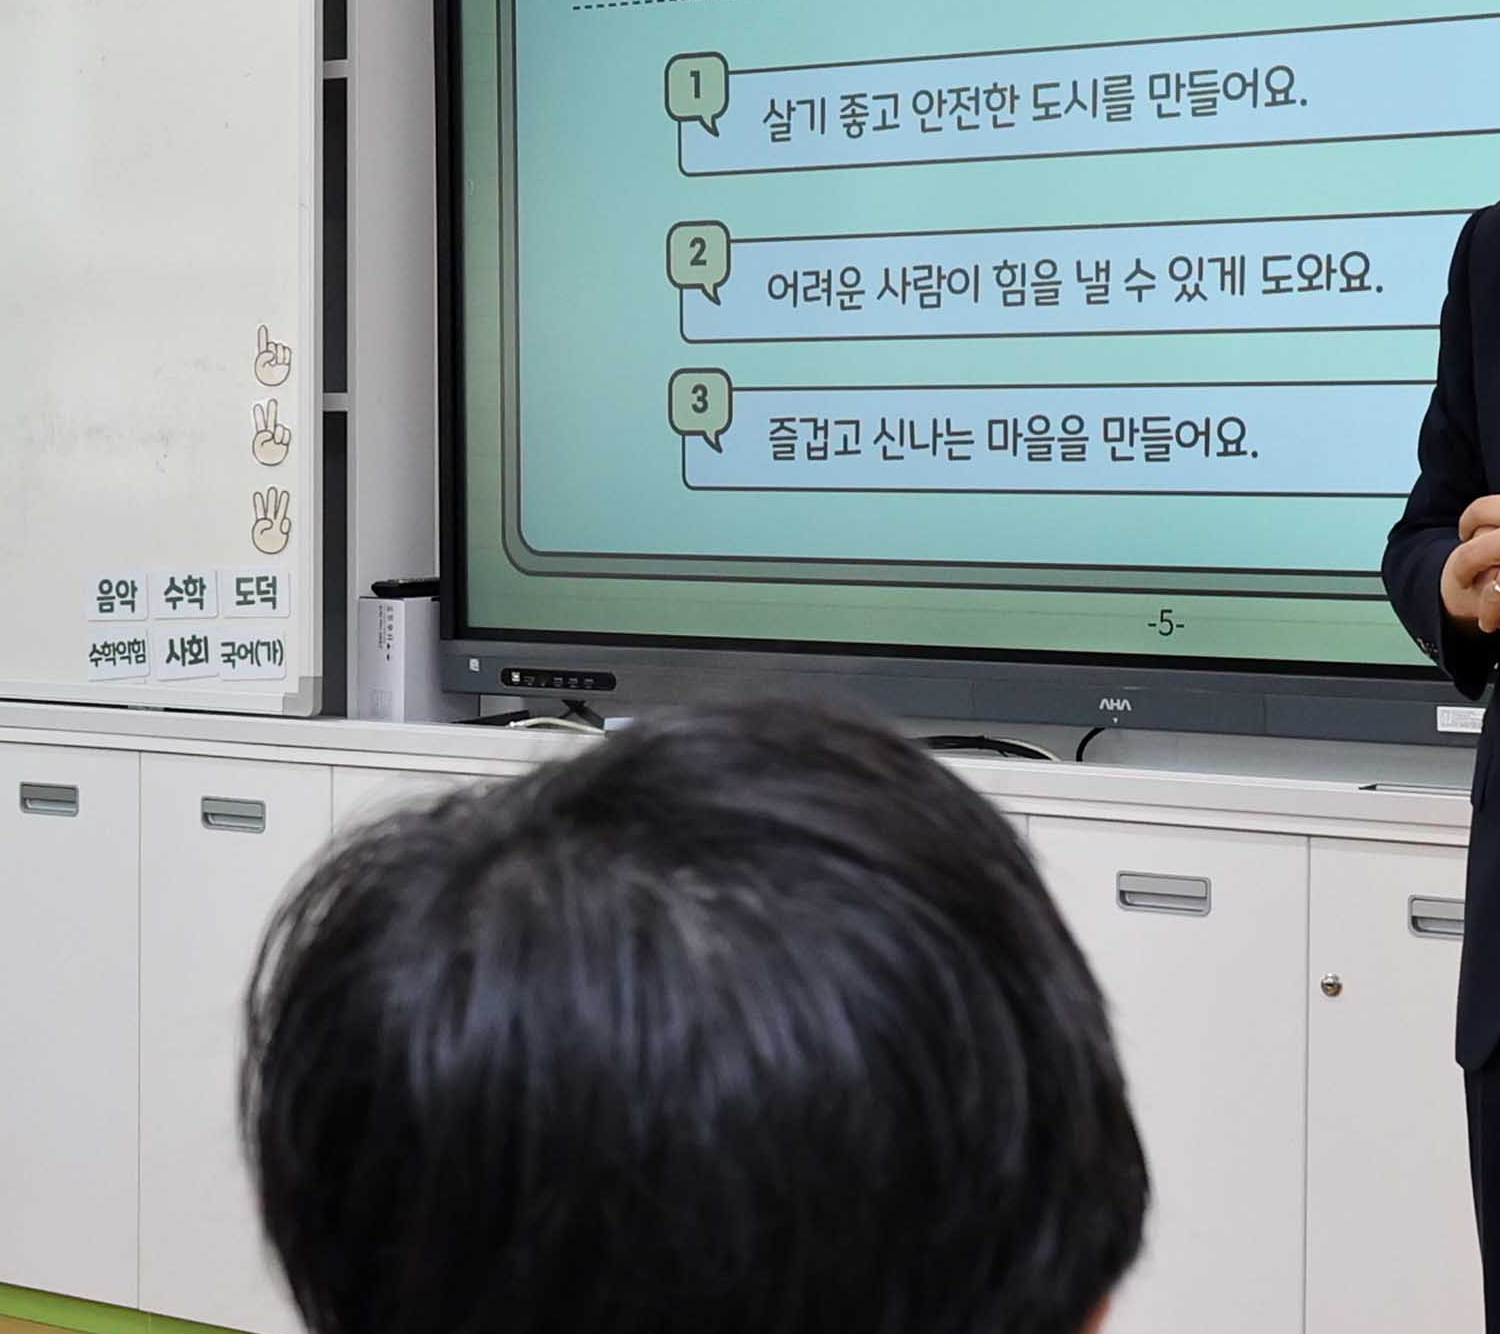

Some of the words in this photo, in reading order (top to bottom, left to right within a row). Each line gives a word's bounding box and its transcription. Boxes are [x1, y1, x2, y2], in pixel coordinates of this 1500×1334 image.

[689, 70, 702, 99] 1
[763, 94, 827, 143] 살기
[838, 92, 901, 138] 좋고
[911, 83, 1020, 133] 안전한
[1032, 74, 1136, 121] 도시를
[1148, 65, 1309, 116] 만들어요.
[689, 238, 707, 267] 2
[767, 265, 864, 311] 어려운
[876, 263, 980, 309] 사람이
[992, 258, 1063, 307] 힘을
[1076, 259, 1111, 305] 낼
[1123, 259, 1157, 303] 수
[1168, 254, 1247, 304] 있게
[1261, 249, 1384, 296] 도와요.
[691, 384, 708, 413] 3
[767, 417, 861, 461] 즐겁고
[873, 417, 974, 461] 신나는
[988, 416, 1089, 462] 마을을
[1102, 416, 1259, 462] 만들어요.
[96, 578, 138, 614] 음악
[163, 574, 206, 611] 수학
[235, 575, 278, 610] 도덕
[88, 638, 146, 667] 수학익힘
[165, 634, 209, 667] 사회
[220, 638, 284, 669] 국어(가)
[1099, 698, 1132, 711] AHA
